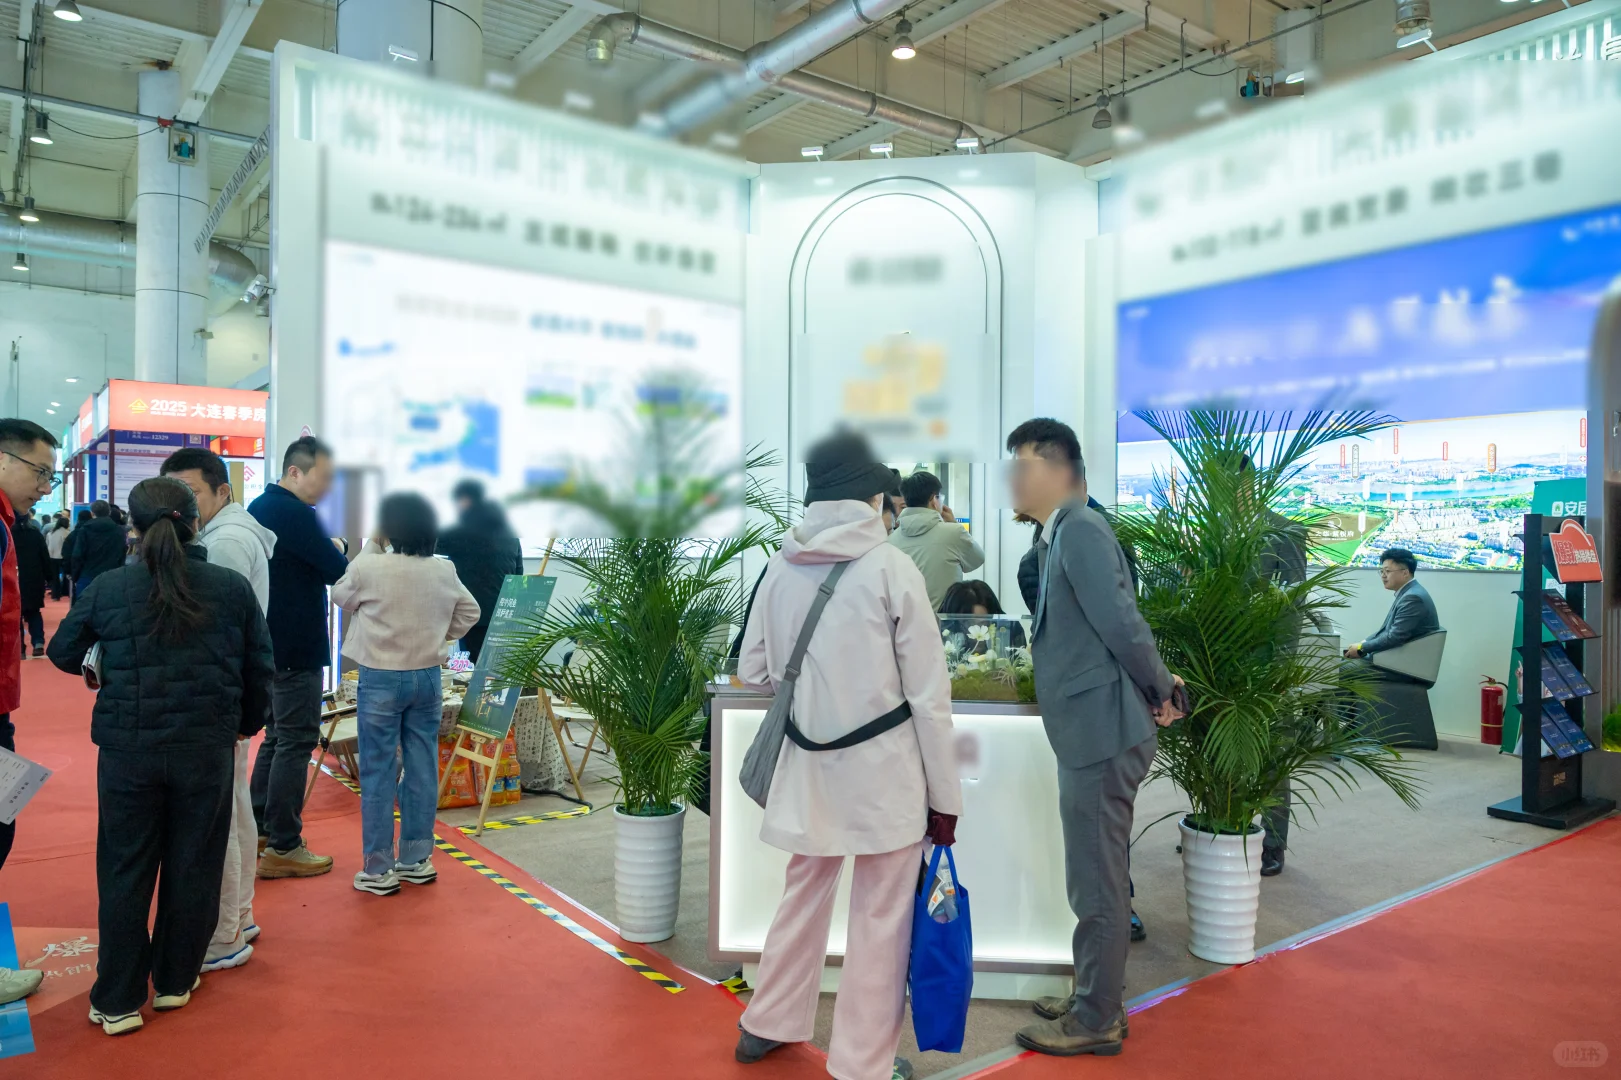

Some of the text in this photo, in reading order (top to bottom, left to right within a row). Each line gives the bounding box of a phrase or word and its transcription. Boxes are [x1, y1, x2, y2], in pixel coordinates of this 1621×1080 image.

[150, 398, 267, 422] 2025 大连春季房
